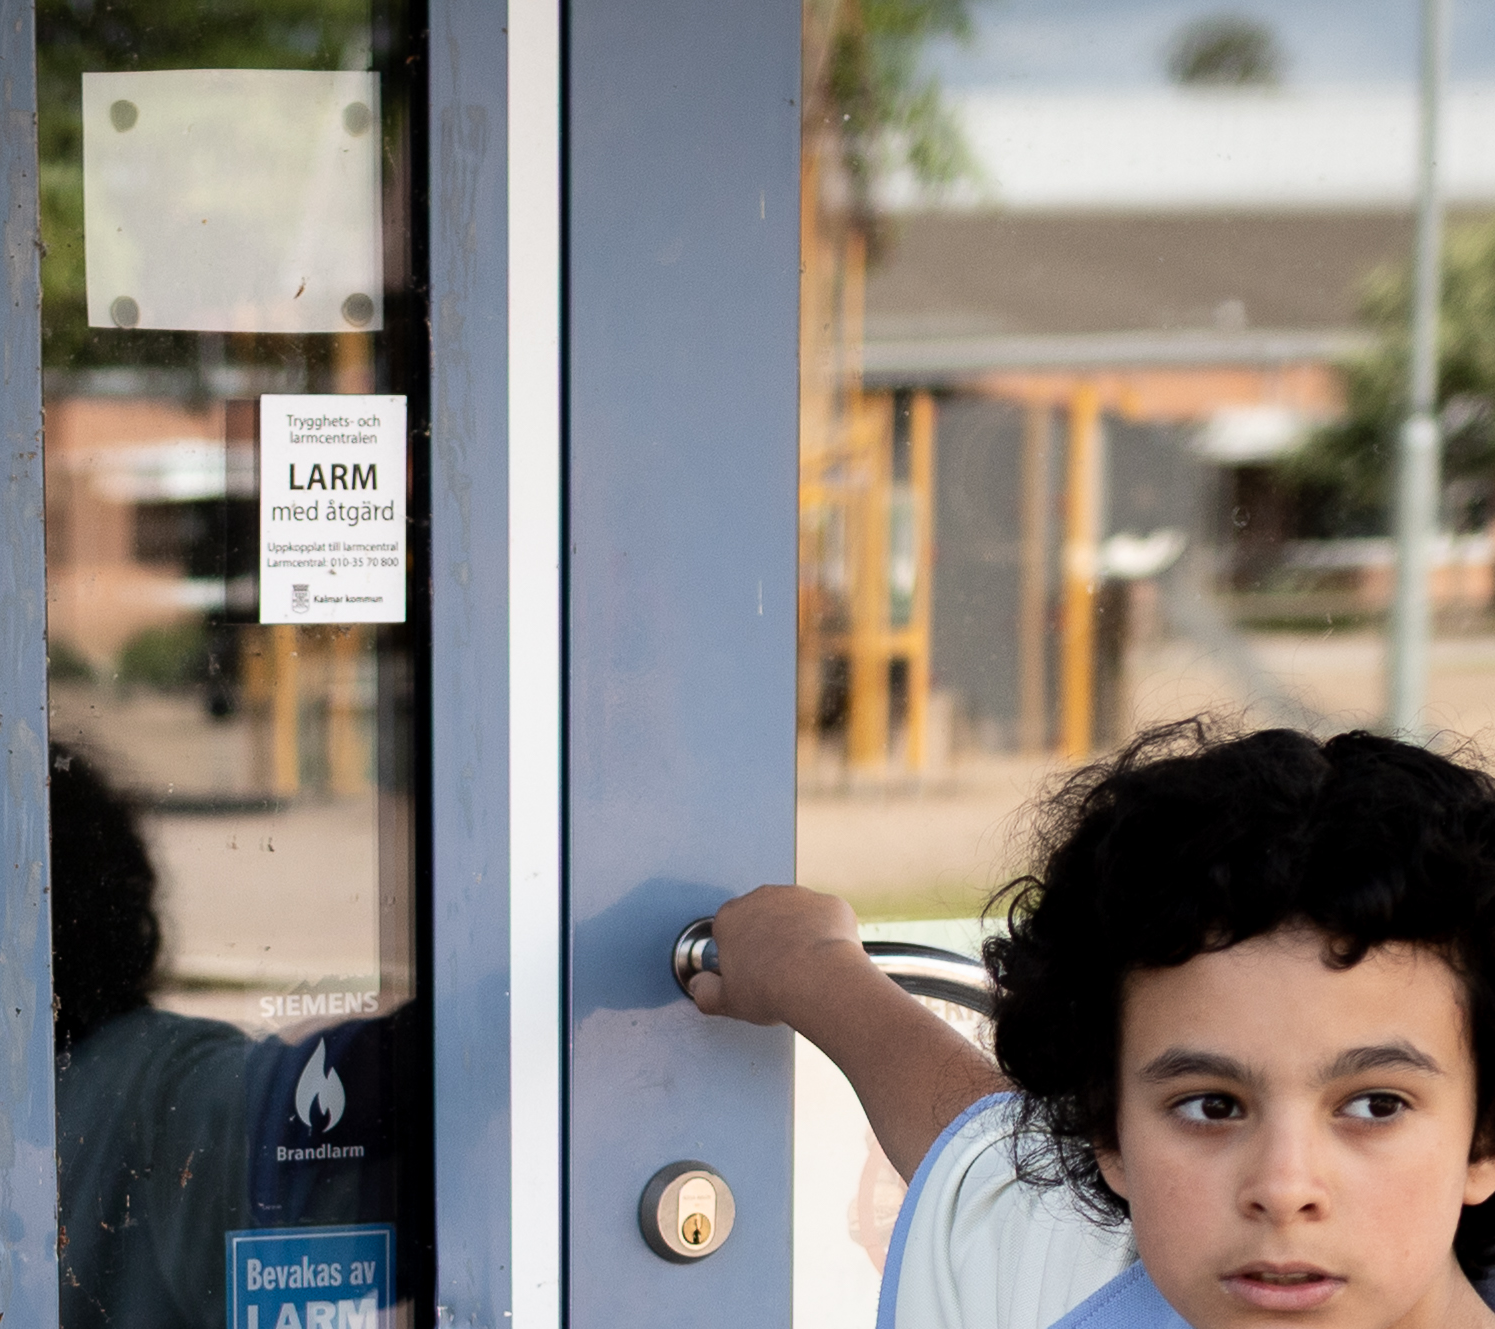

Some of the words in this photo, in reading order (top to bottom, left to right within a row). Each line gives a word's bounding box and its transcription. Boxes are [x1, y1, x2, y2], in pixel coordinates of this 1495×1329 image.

[286, 414, 354, 431] Trygghets-
[357, 413, 381, 427] och
[289, 431, 378, 444] larmcentralen
[289, 463, 378, 491] LARM
[272, 499, 319, 521] med
[325, 499, 395, 527] åtgärd
[343, 541, 399, 552] larmcentral
[260, 990, 380, 1019] SIEMENS
[276, 1143, 365, 1162] Brandlarm
[246, 1255, 343, 1291] Bevakas
[349, 1260, 377, 1286] av
